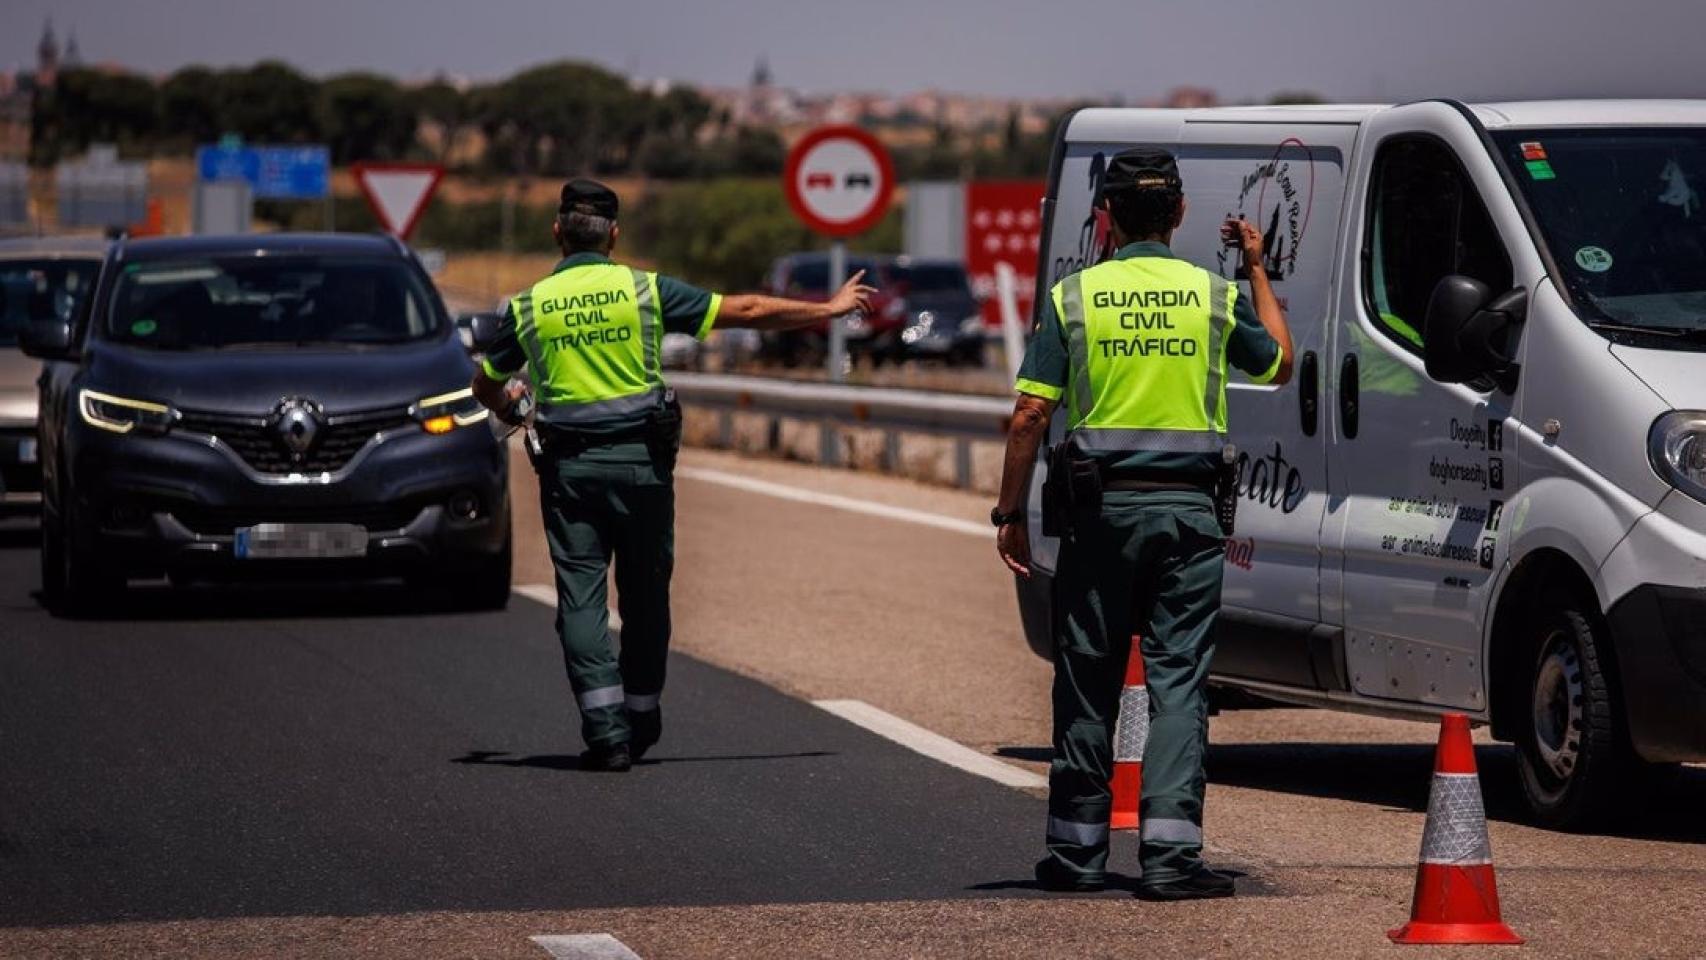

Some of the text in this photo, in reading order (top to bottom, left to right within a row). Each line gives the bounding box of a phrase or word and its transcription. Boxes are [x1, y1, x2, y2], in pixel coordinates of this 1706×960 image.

[541, 290, 629, 315] GUARDIA
[1093, 290, 1200, 308] GUARDIA
[564, 309, 610, 327] CIVIL
[1120, 312, 1175, 329] CIVIL
[550, 326, 631, 352] TRÁFICO
[1098, 334, 1196, 357] TRÁFICO
[1238, 441, 1304, 514] cate
